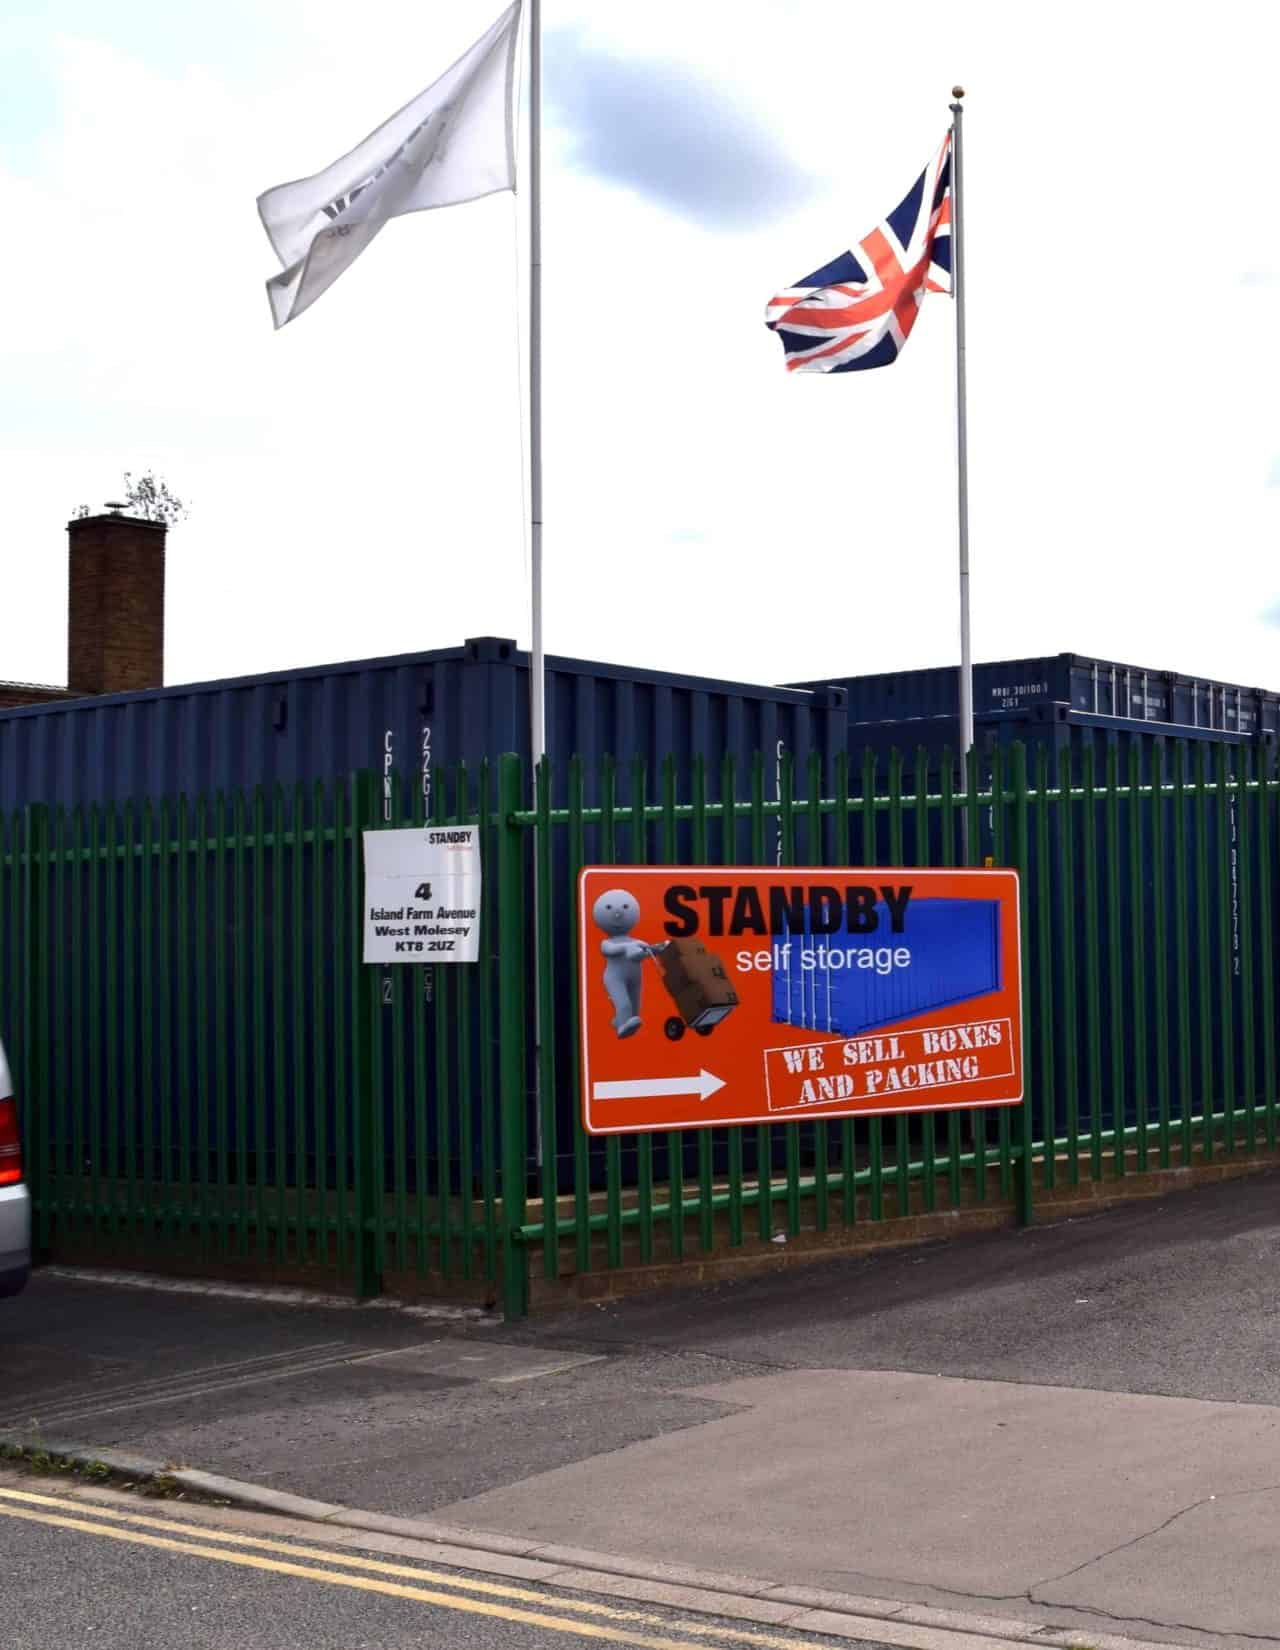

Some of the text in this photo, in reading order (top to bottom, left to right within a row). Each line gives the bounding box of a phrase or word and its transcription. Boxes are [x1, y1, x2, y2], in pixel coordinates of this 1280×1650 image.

[429, 831, 472, 844] STANDBY
[414, 882, 432, 901] 4
[370, 906, 476, 920] Island Farm Avenue
[663, 885, 913, 937] STANDBY
[375, 925, 471, 937] West Molesey
[395, 941, 455, 952] KT8 2UZ
[735, 943, 912, 975] self storage
[782, 1023, 1002, 1074] WE SELL BOXES
[799, 1055, 979, 1104] AND PACKING
